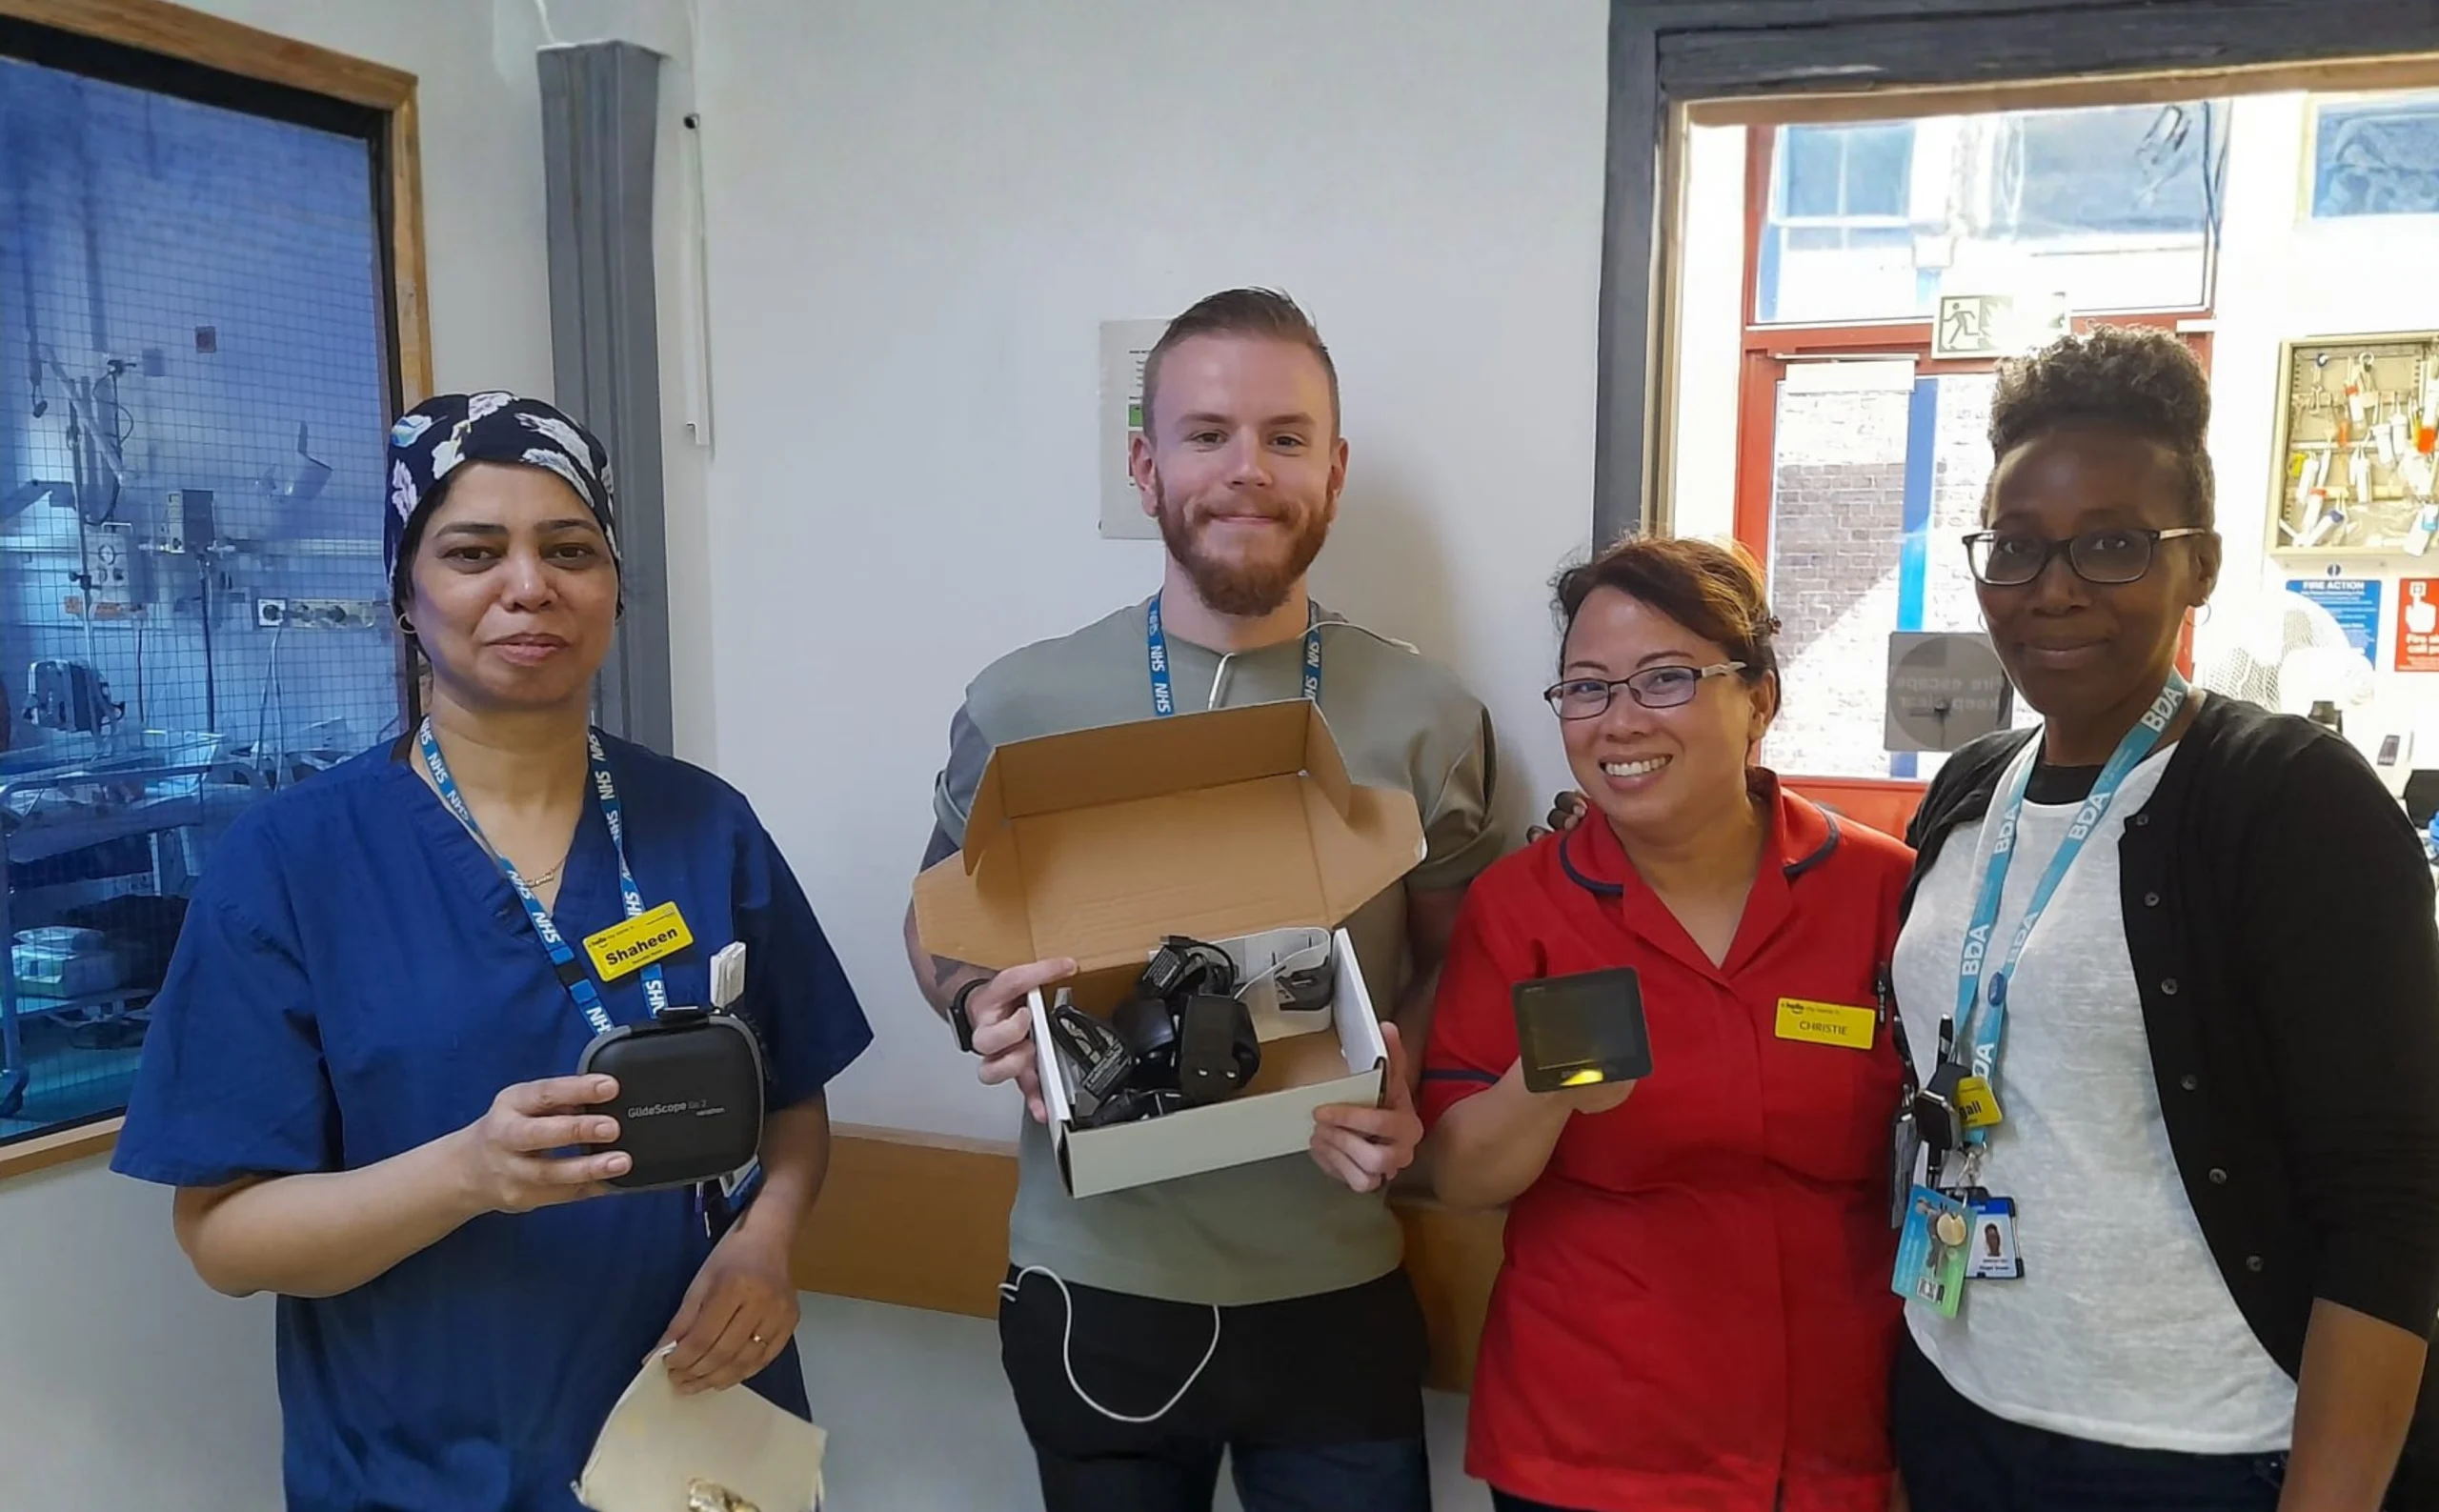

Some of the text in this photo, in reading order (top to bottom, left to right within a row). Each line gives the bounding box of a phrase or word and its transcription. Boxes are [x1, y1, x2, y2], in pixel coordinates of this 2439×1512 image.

[2302, 581, 2365, 590] FIRE ACTION
[1151, 645, 1165, 672] NHS
[1154, 682, 1172, 714] NHS
[2141, 686, 2183, 733] BDA
[427, 752, 450, 784] NHS
[595, 770, 615, 800] NHS
[1993, 802, 2020, 855] BDA
[2068, 792, 2112, 840] BDA
[506, 869, 535, 900] NHS
[532, 911, 561, 943] NHS
[605, 927, 678, 965] Shaheen
[1962, 923, 1990, 977] BDA
[586, 1006, 612, 1036] NH
[1799, 1020, 1848, 1036] CHRISTIE
[1972, 1042, 1994, 1082] DA
